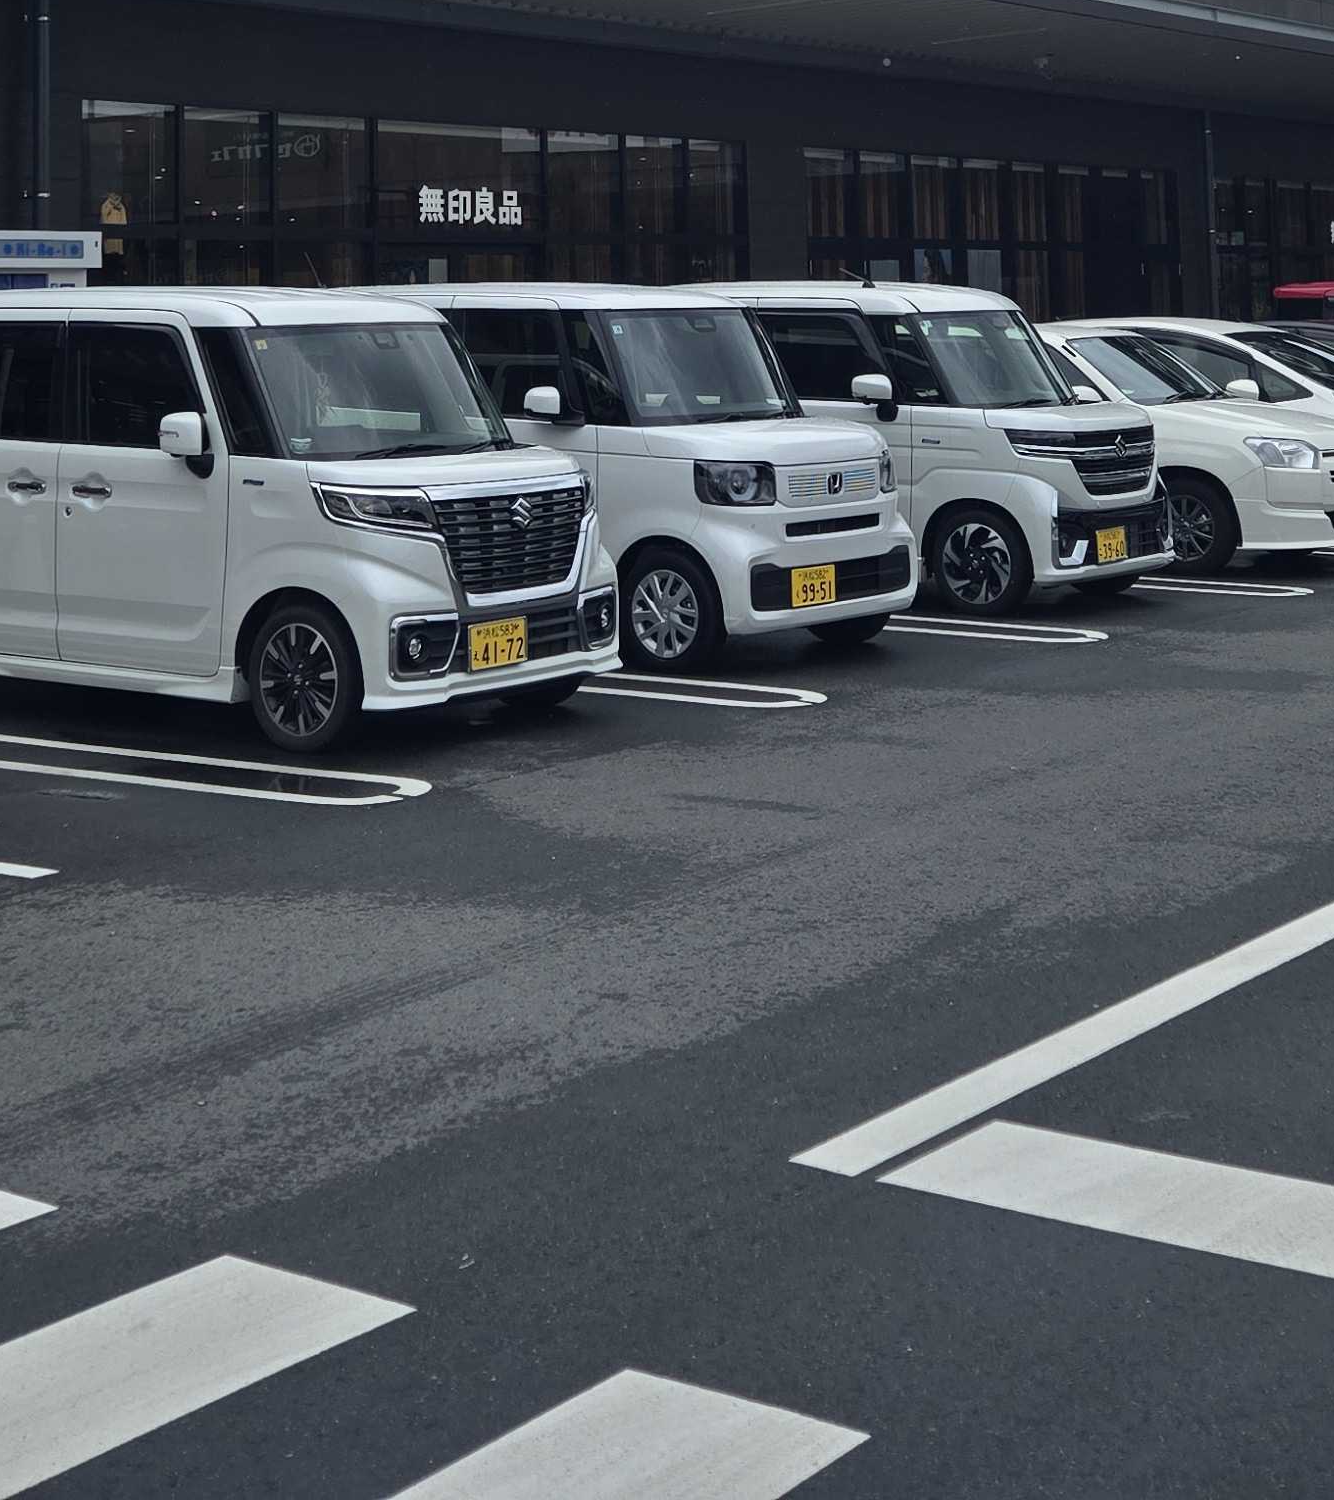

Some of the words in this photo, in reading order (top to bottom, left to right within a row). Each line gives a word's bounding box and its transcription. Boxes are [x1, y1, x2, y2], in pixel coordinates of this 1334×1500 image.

[418, 184, 523, 226] 無印良品
[802, 580, 832, 603] 99-51
[482, 636, 524, 665] 41-72
